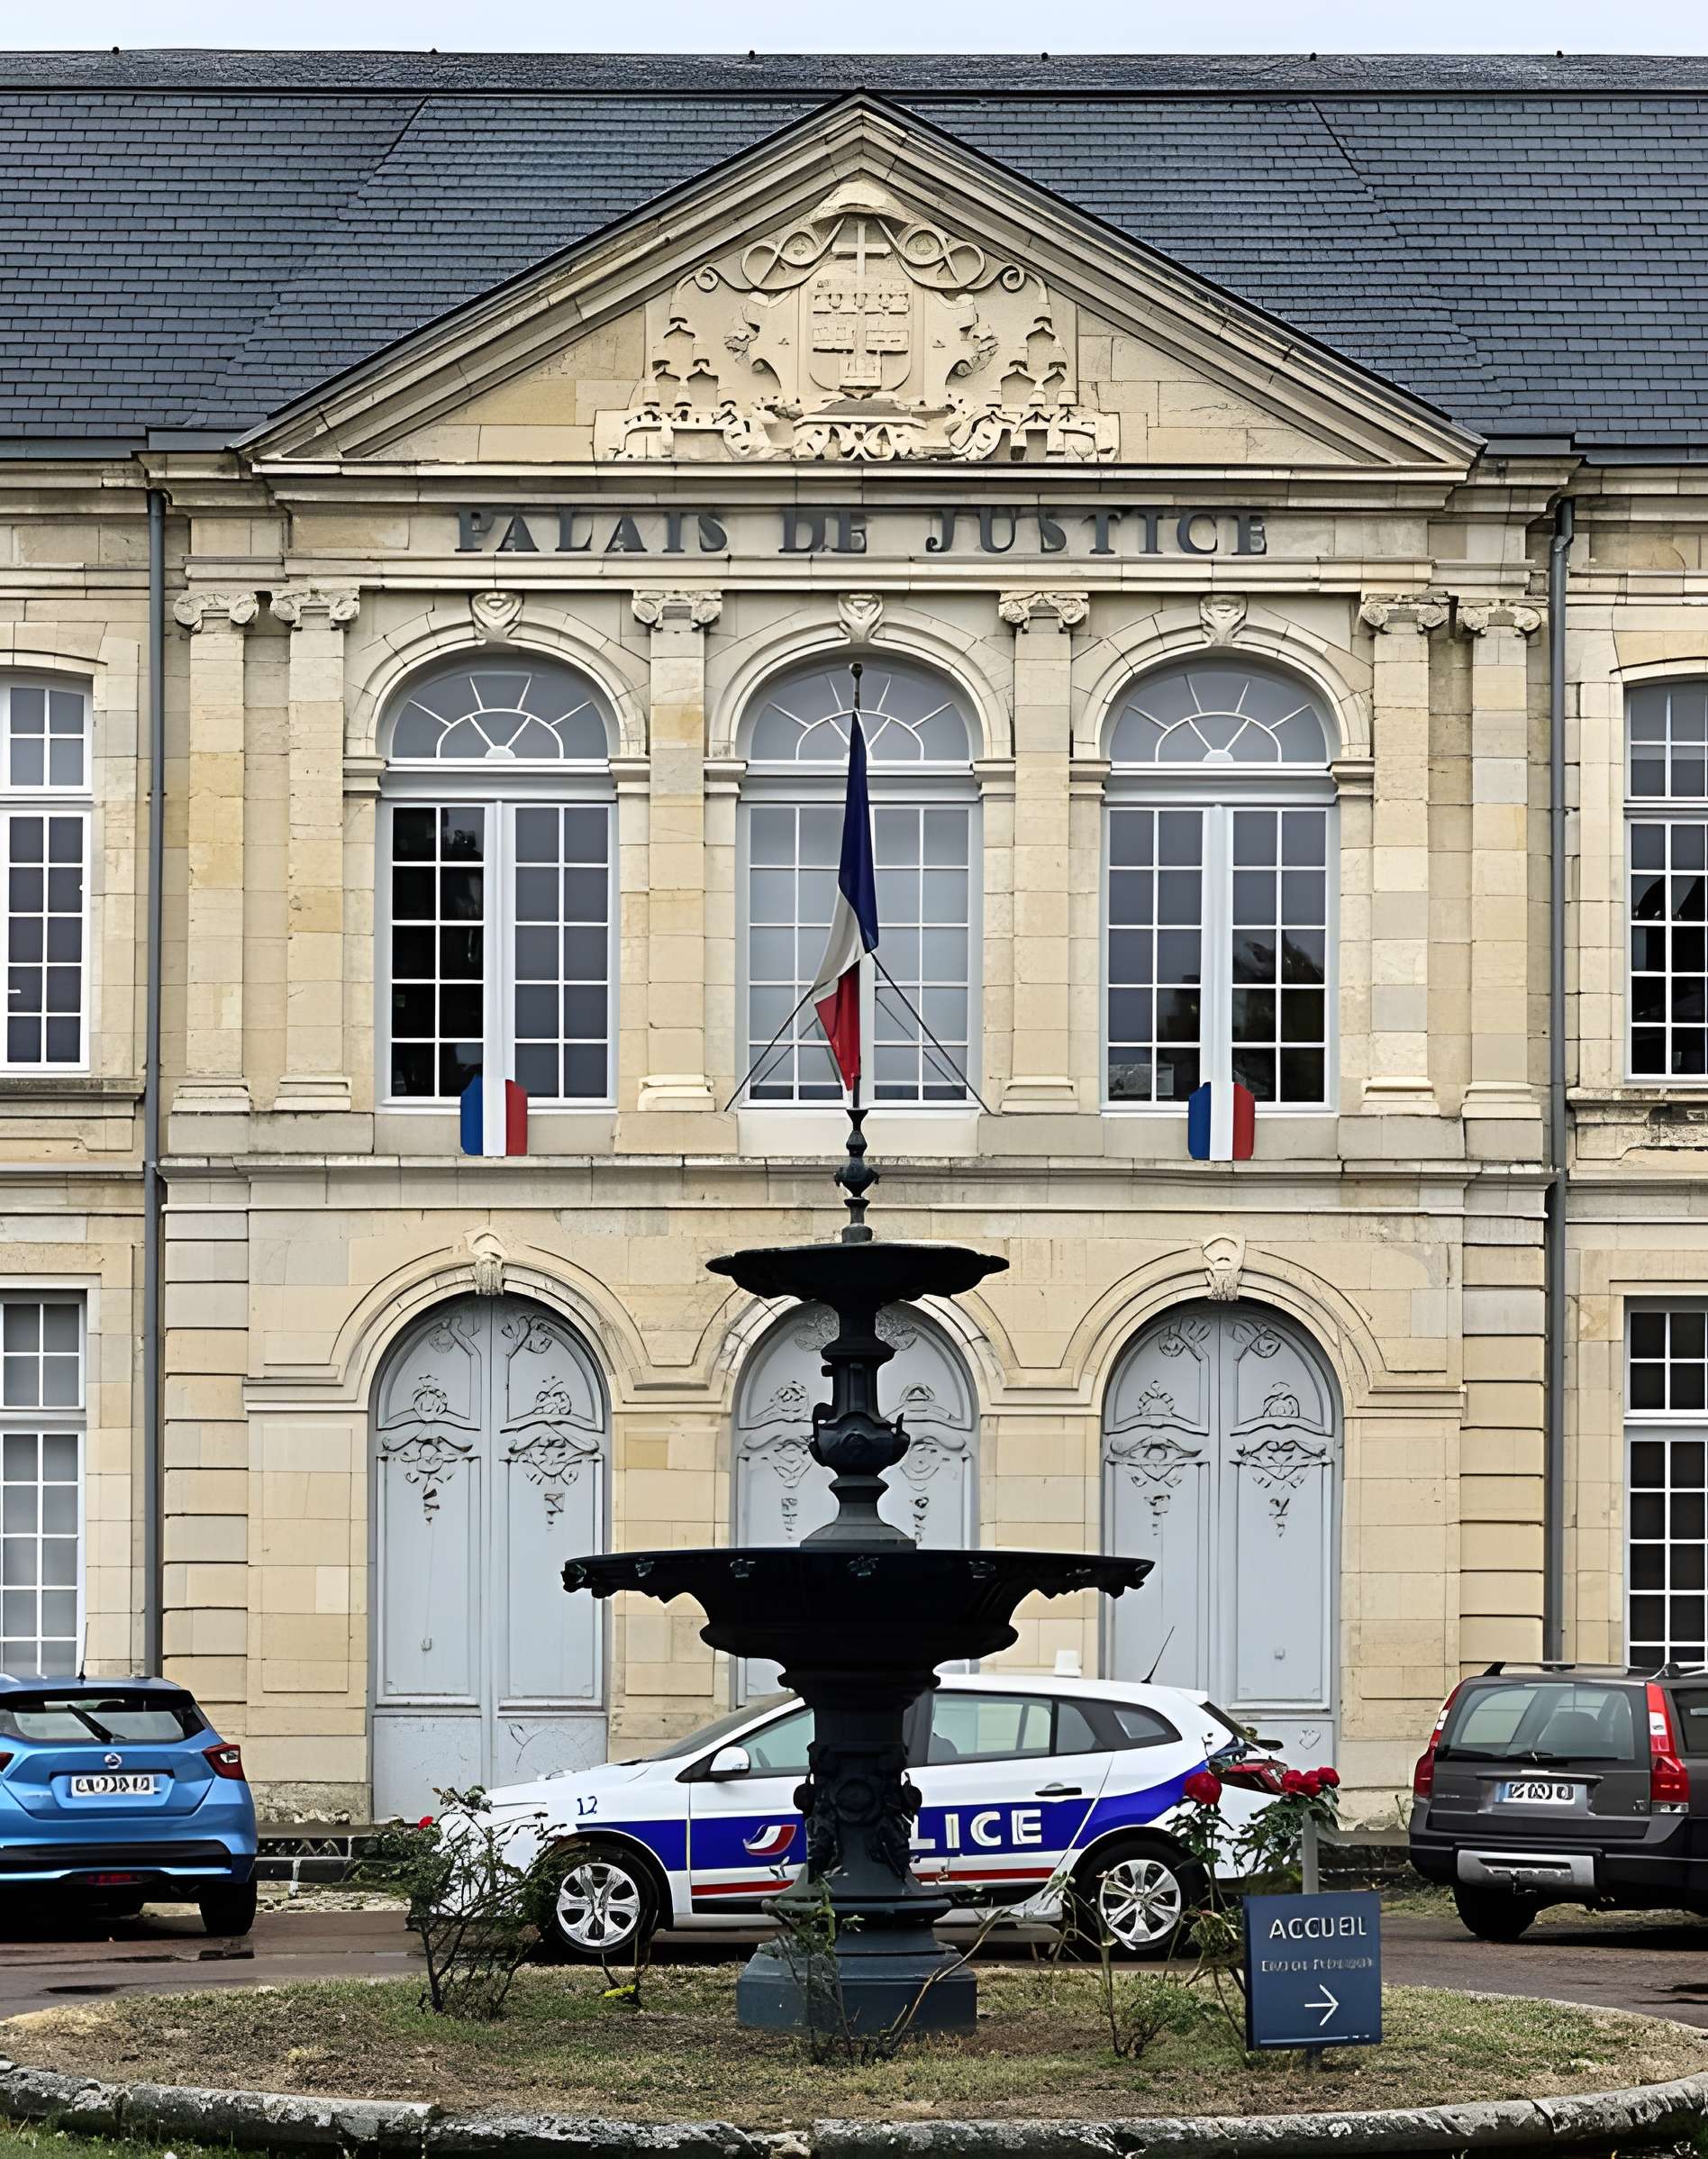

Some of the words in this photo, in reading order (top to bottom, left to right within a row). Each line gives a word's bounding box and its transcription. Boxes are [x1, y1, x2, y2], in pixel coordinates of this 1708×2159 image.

[455, 509, 728, 553] PALAIS
[778, 509, 867, 553] DE
[925, 509, 1267, 555] JUSTICE
[577, 1796, 597, 1816] 12
[909, 1809, 1042, 1850] LICE
[1268, 1916, 1367, 1939] ACCUEIL
